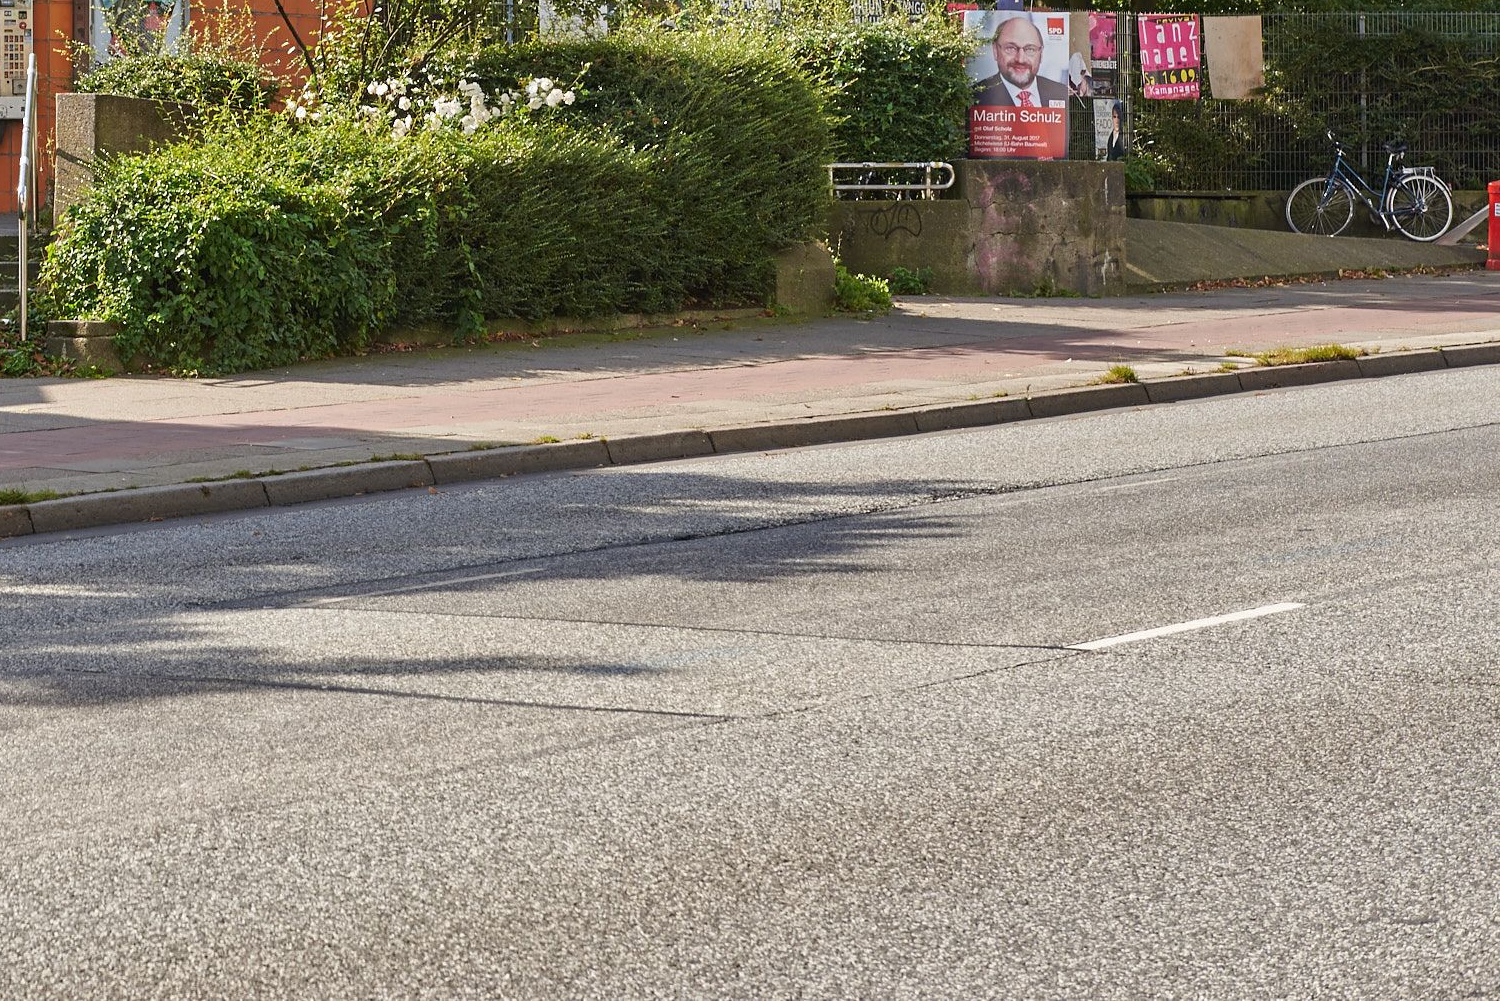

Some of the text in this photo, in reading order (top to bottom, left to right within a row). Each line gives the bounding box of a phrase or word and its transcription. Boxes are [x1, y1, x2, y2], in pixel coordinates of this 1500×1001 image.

[1048, 27, 1063, 35] SPD
[1138, 16, 1198, 45] Tanz
[973, 109, 1062, 124] Martin Schulz
